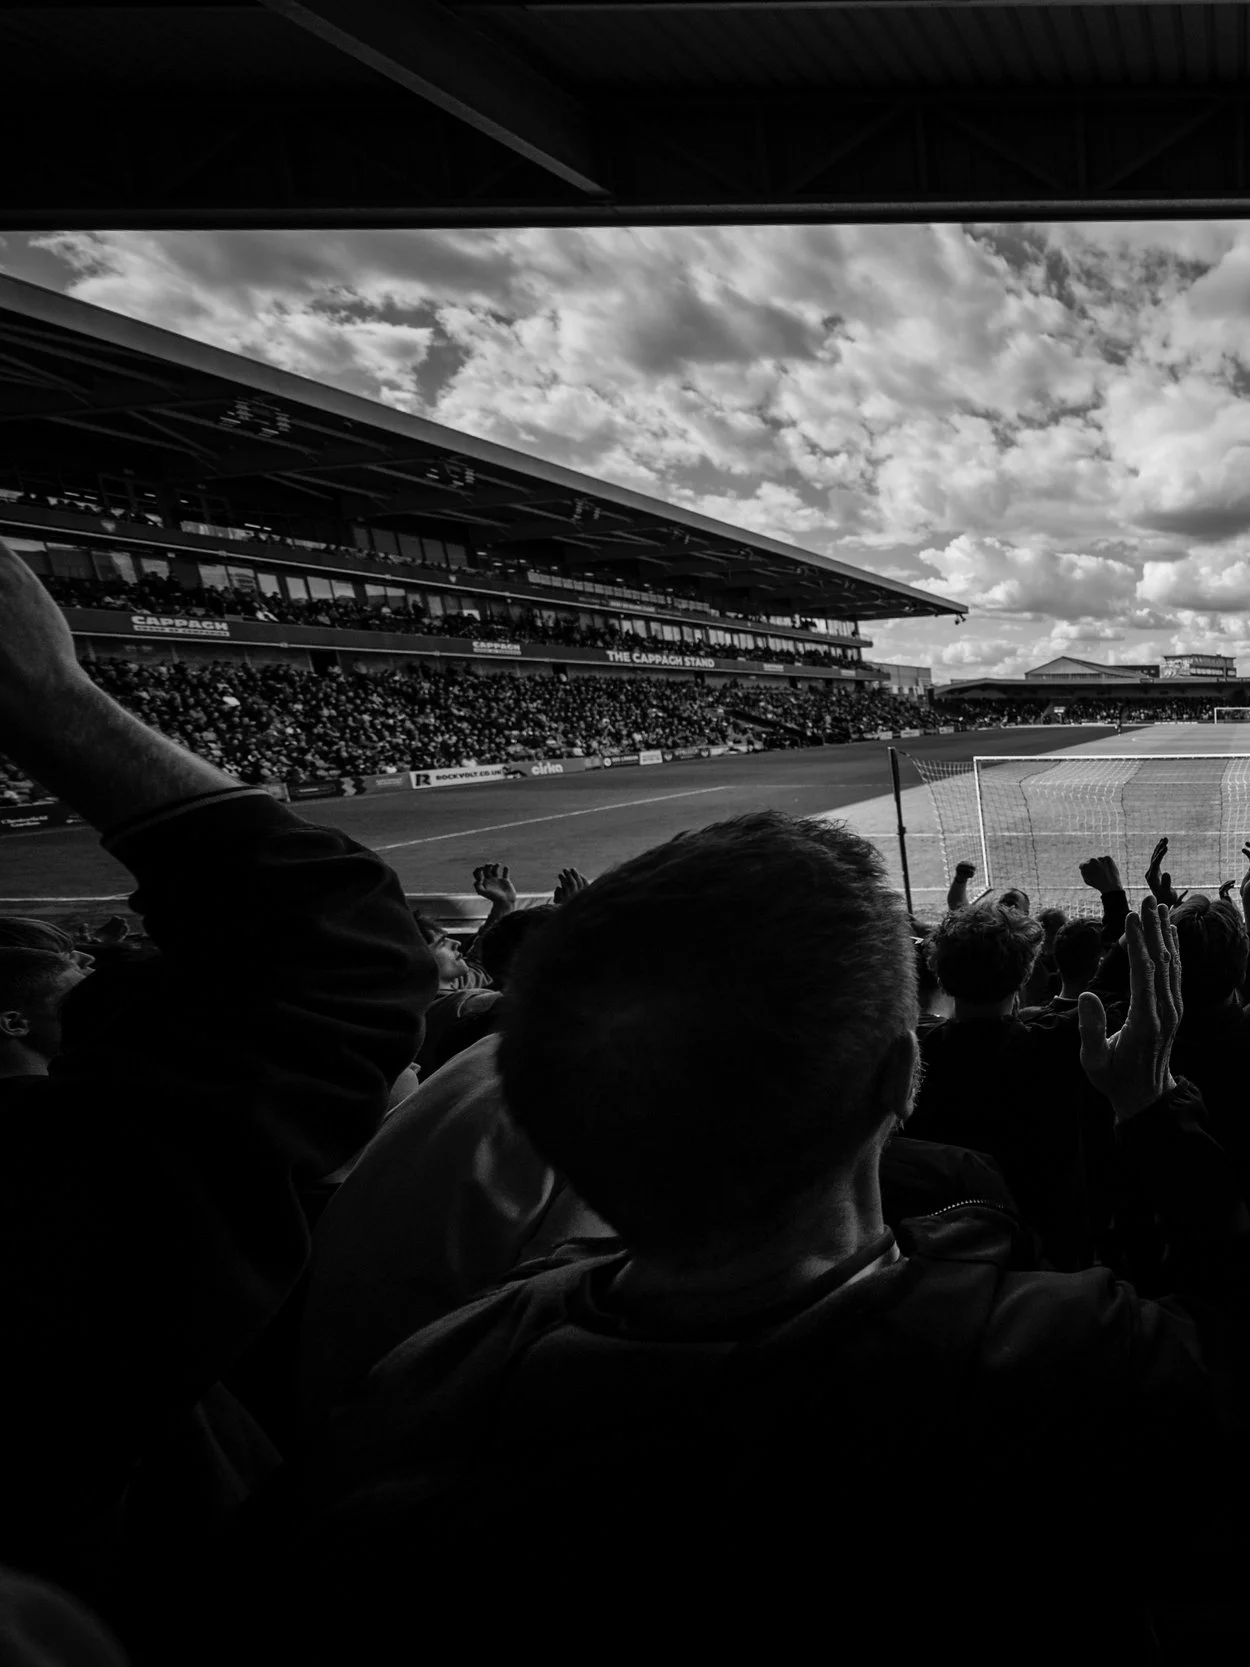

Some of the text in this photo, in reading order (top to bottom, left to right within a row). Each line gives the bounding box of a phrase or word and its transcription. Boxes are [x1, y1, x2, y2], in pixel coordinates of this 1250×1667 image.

[130, 615, 229, 631] CAPPAGH
[605, 650, 716, 668] THE CAPPAGH STAND
[531, 762, 564, 775] cirka
